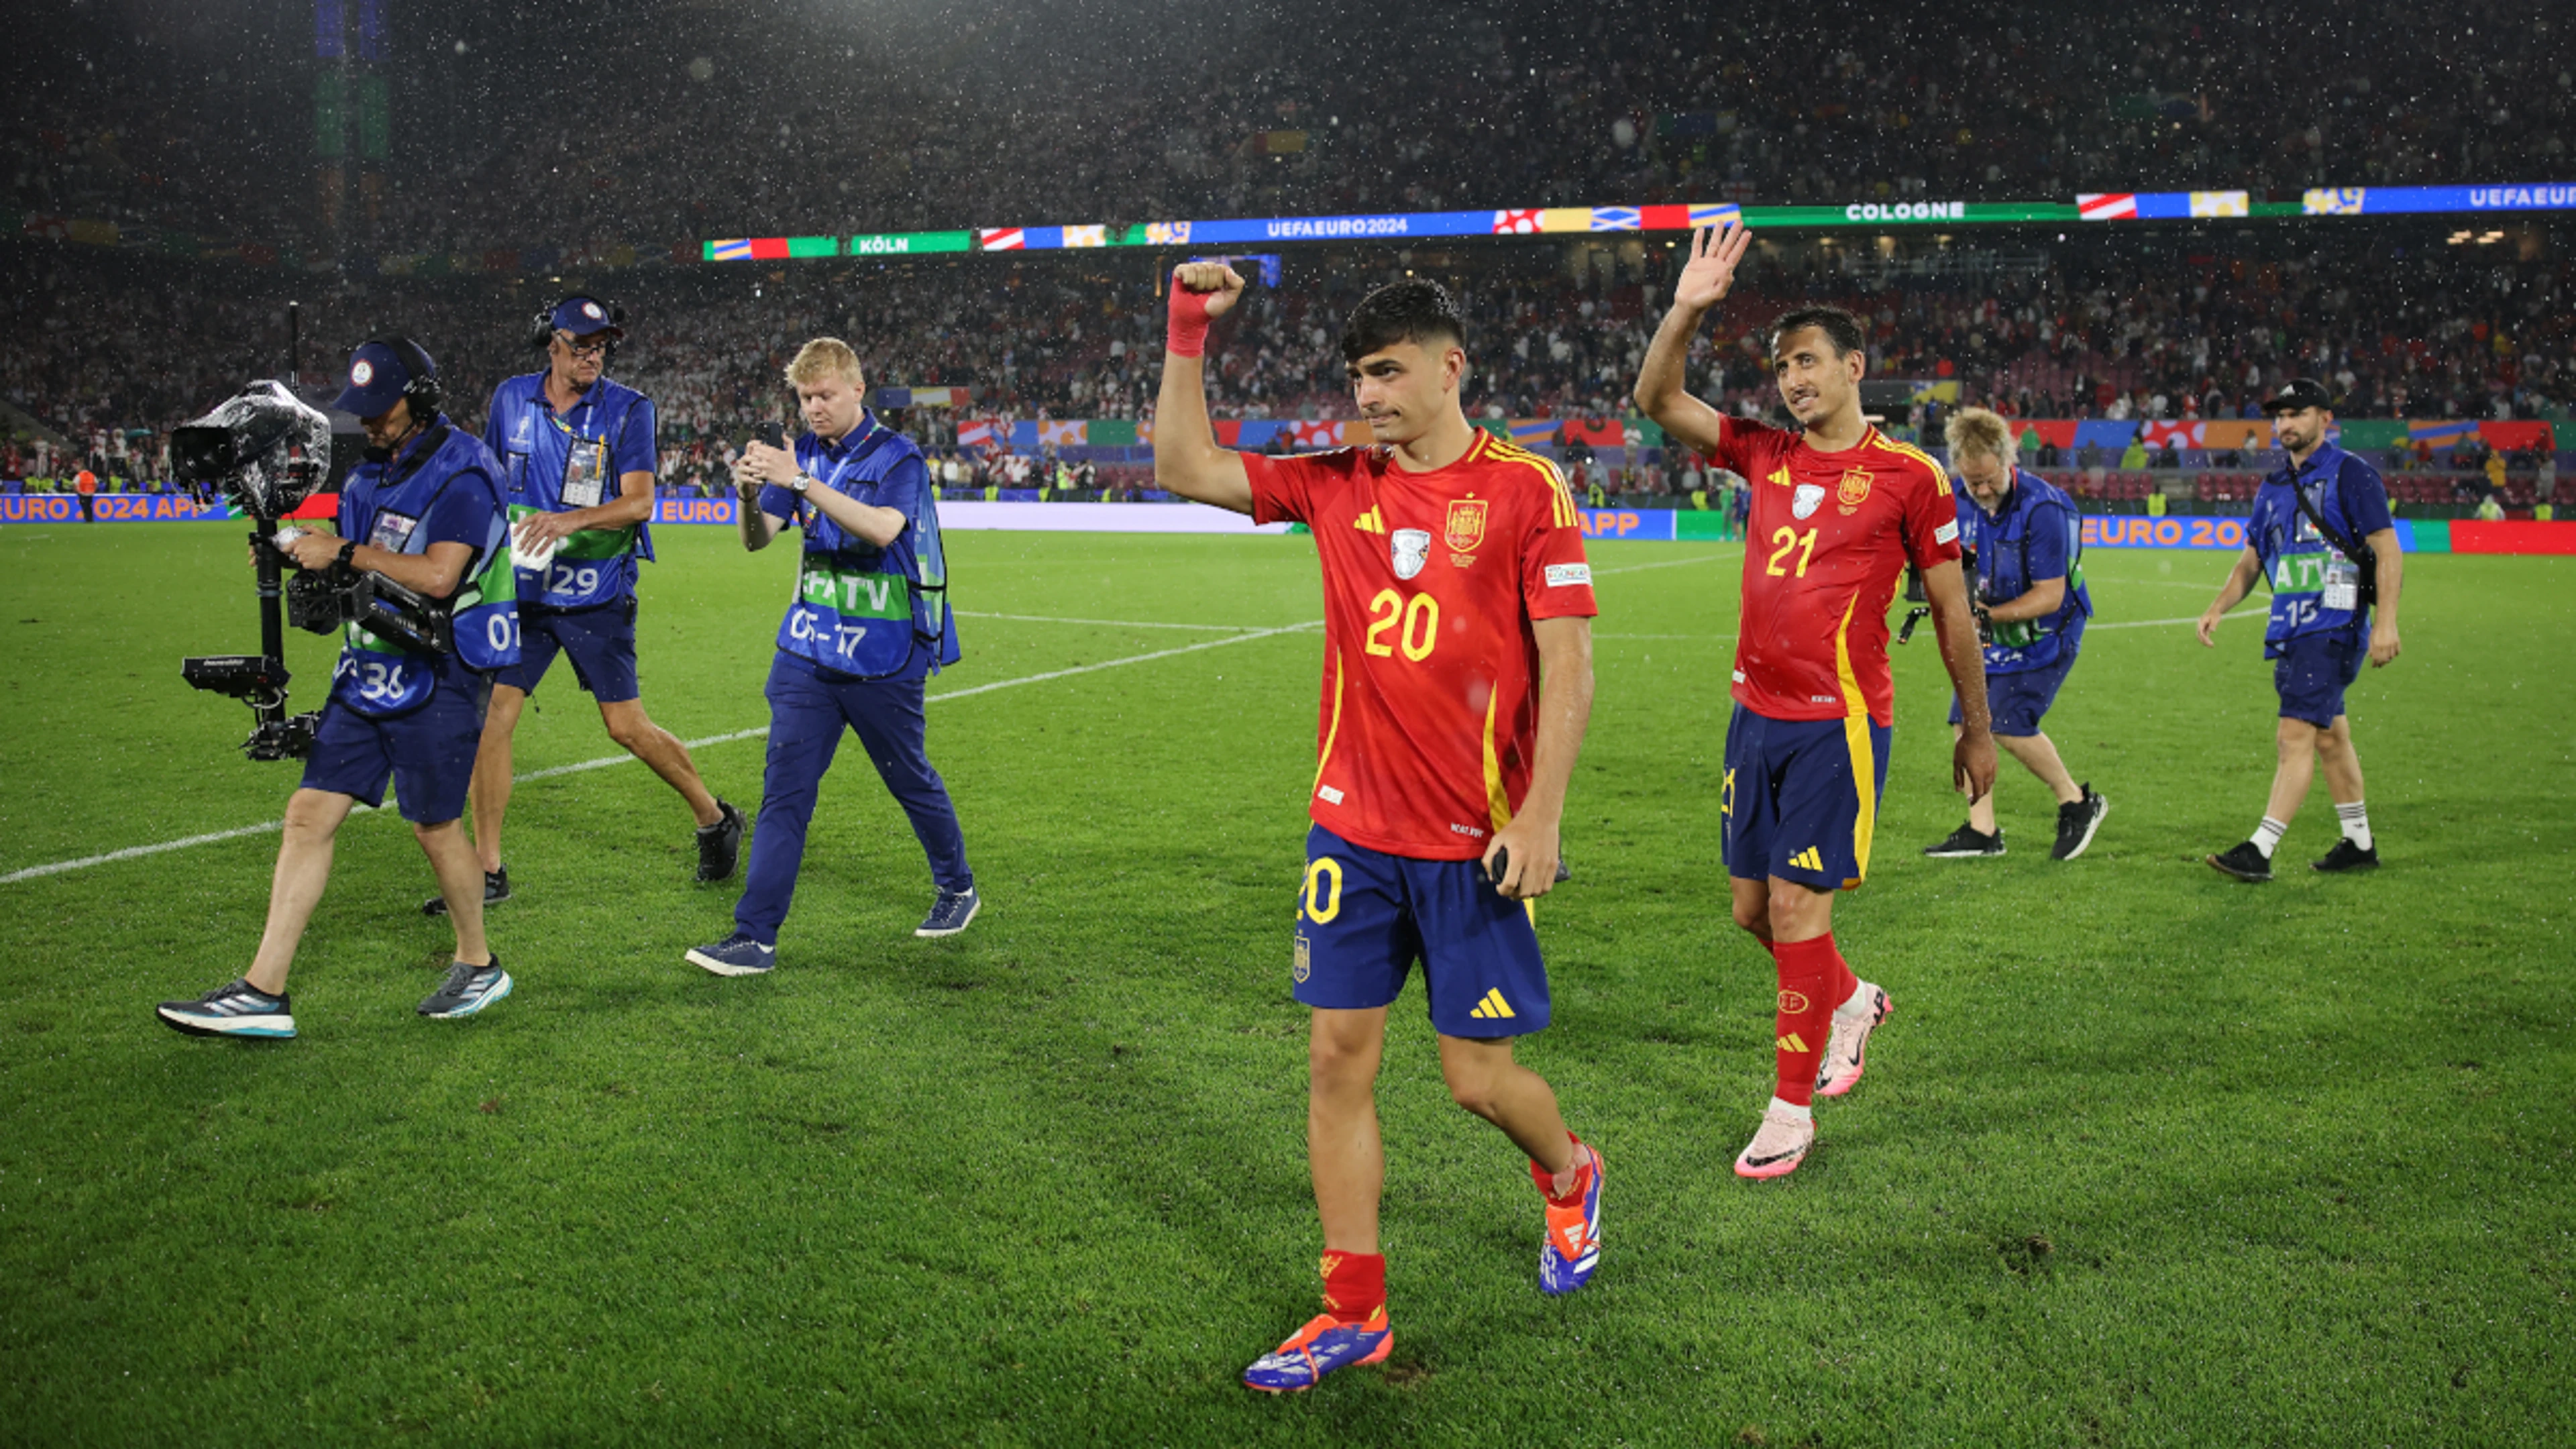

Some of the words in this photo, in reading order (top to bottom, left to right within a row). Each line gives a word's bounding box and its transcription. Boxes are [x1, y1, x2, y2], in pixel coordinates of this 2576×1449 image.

[1846, 202, 1964, 221] COLOGNE
[860, 235, 908, 254] KÖLN
[0, 498, 69, 520] URO
[662, 501, 731, 522] EURO
[2082, 519, 2183, 545] EURO
[2190, 520, 2249, 545] 20
[1766, 526, 1818, 578] 21
[841, 575, 890, 611] TV
[1365, 588, 1440, 662] 20
